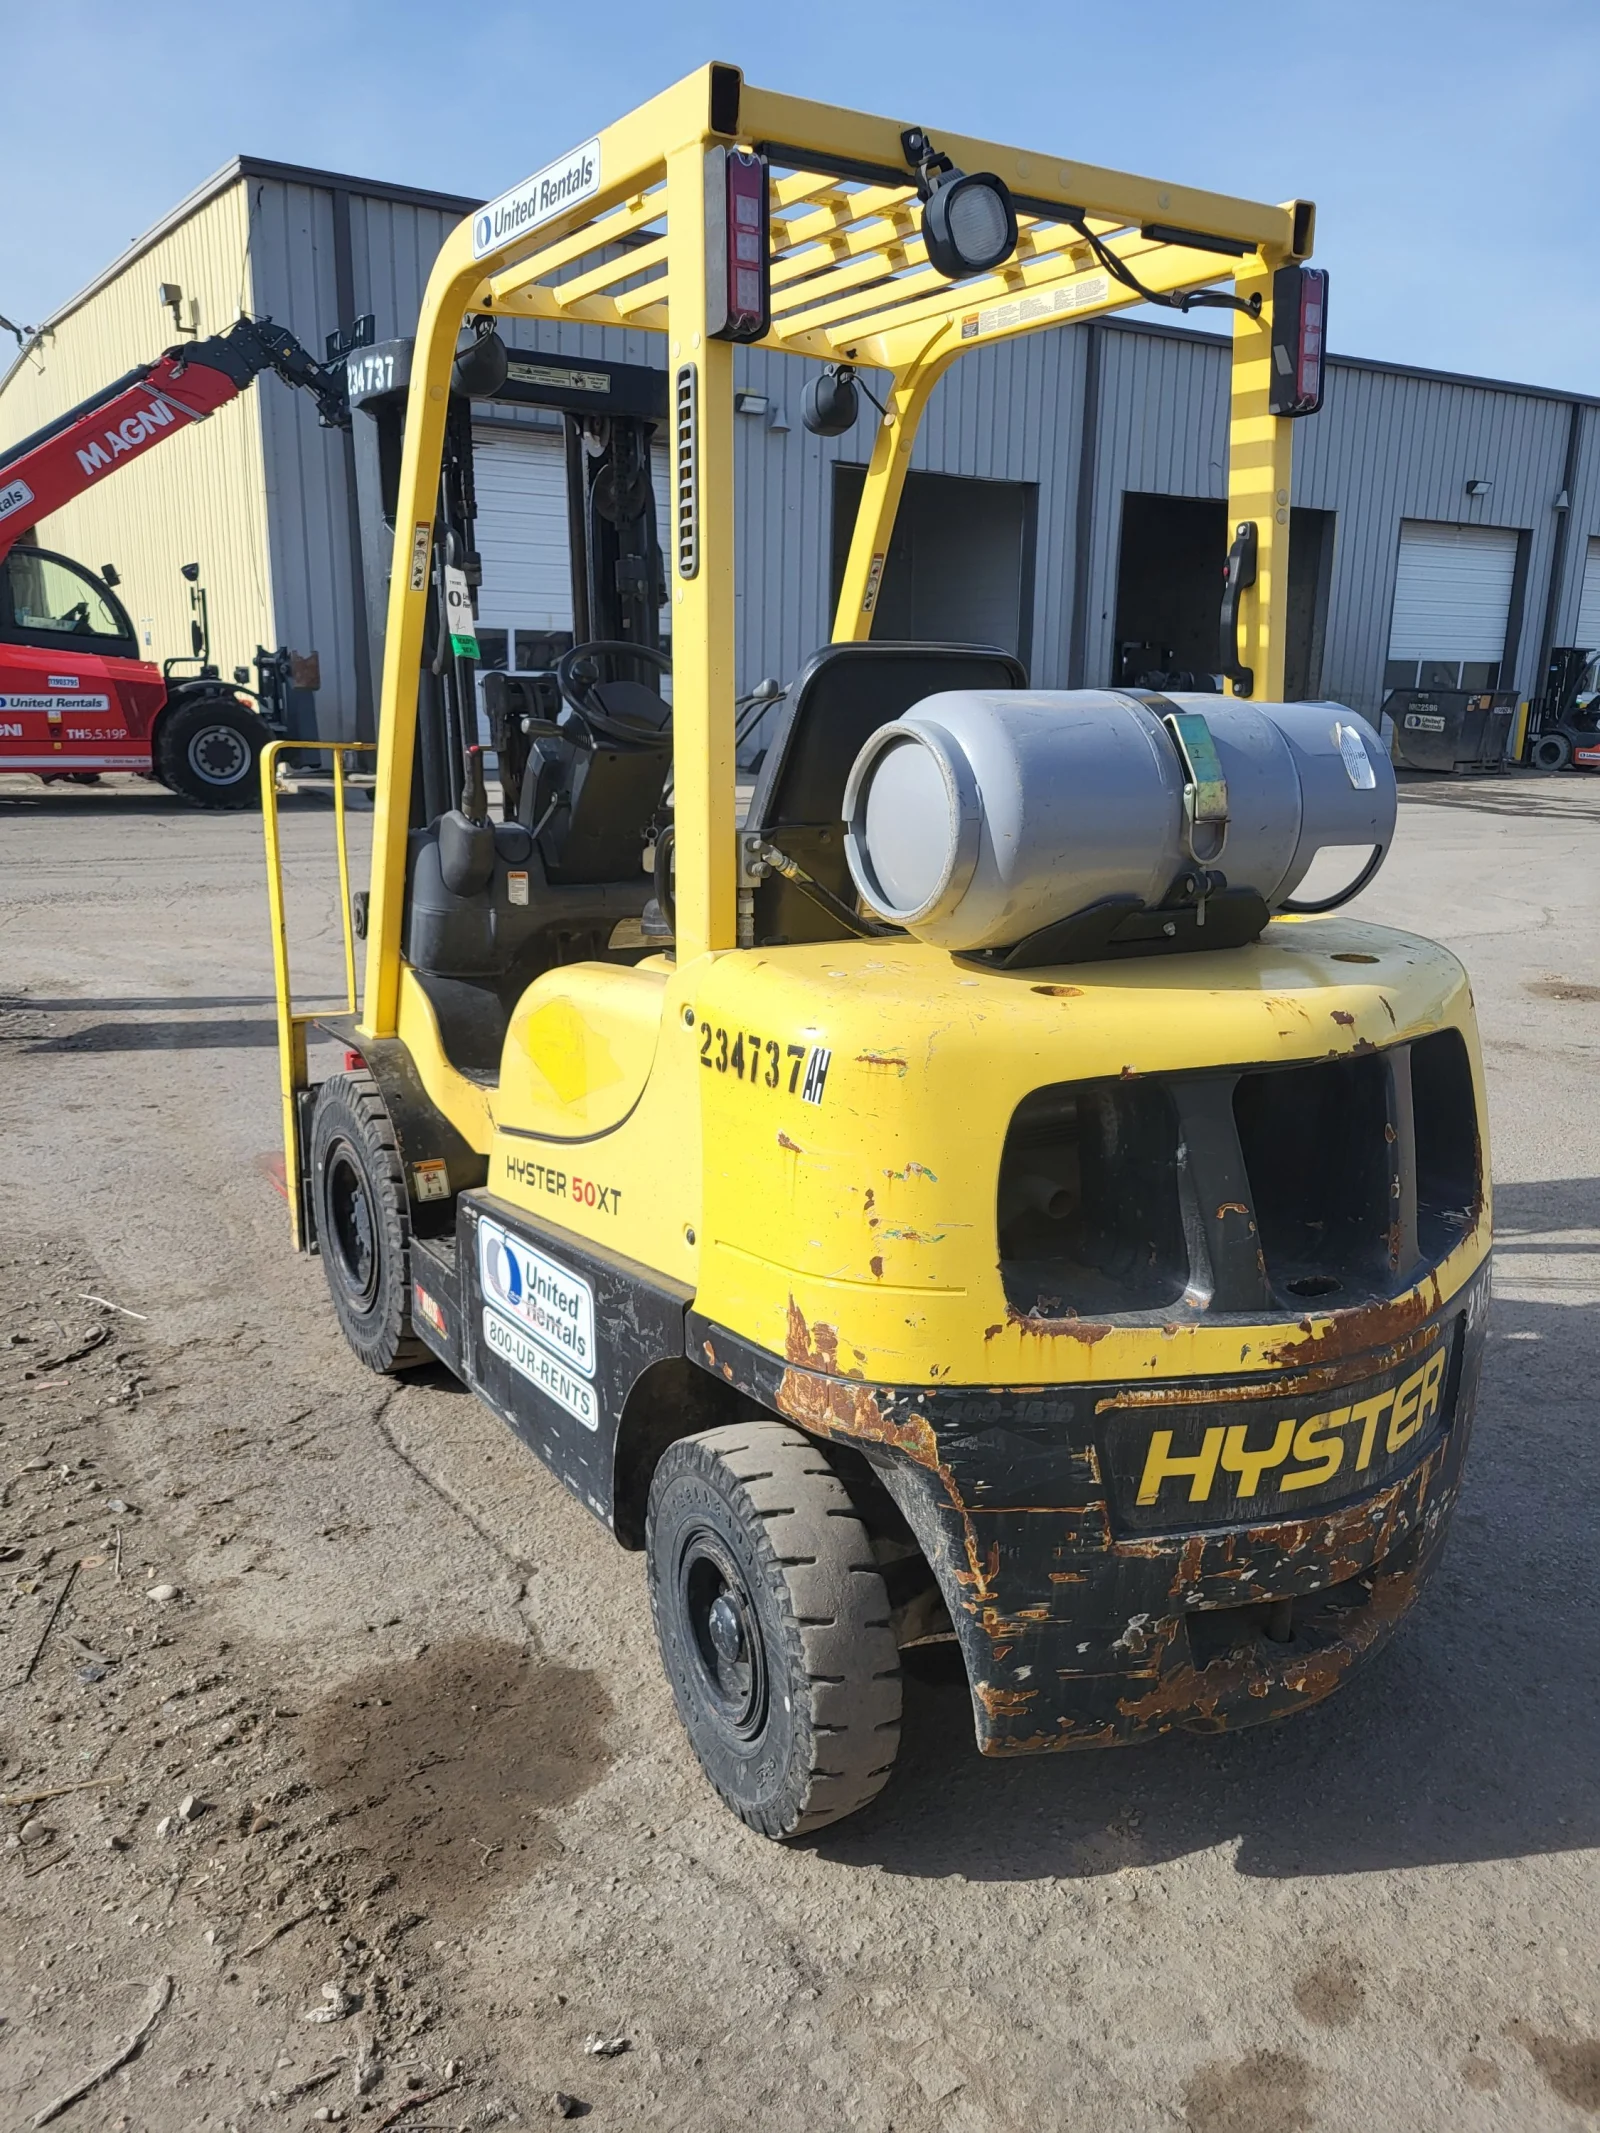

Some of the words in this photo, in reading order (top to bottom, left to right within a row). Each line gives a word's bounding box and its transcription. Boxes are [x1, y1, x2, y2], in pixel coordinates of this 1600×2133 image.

[493, 187, 537, 238] United
[540, 155, 594, 212] Rentals
[347, 354, 394, 396] 234737
[75, 398, 176, 476] MAGNI
[10, 697, 53, 708] United
[56, 697, 103, 708] Rentals
[700, 1022, 806, 1094] 234737
[506, 1155, 567, 1198] HYSTER
[572, 1176, 622, 1216] 50XT
[525, 1260, 580, 1321] United
[526, 1293, 587, 1357] Rentals
[489, 1320, 591, 1416] 800-UR-RENTS
[1135, 1346, 1446, 1506] HYSTER
